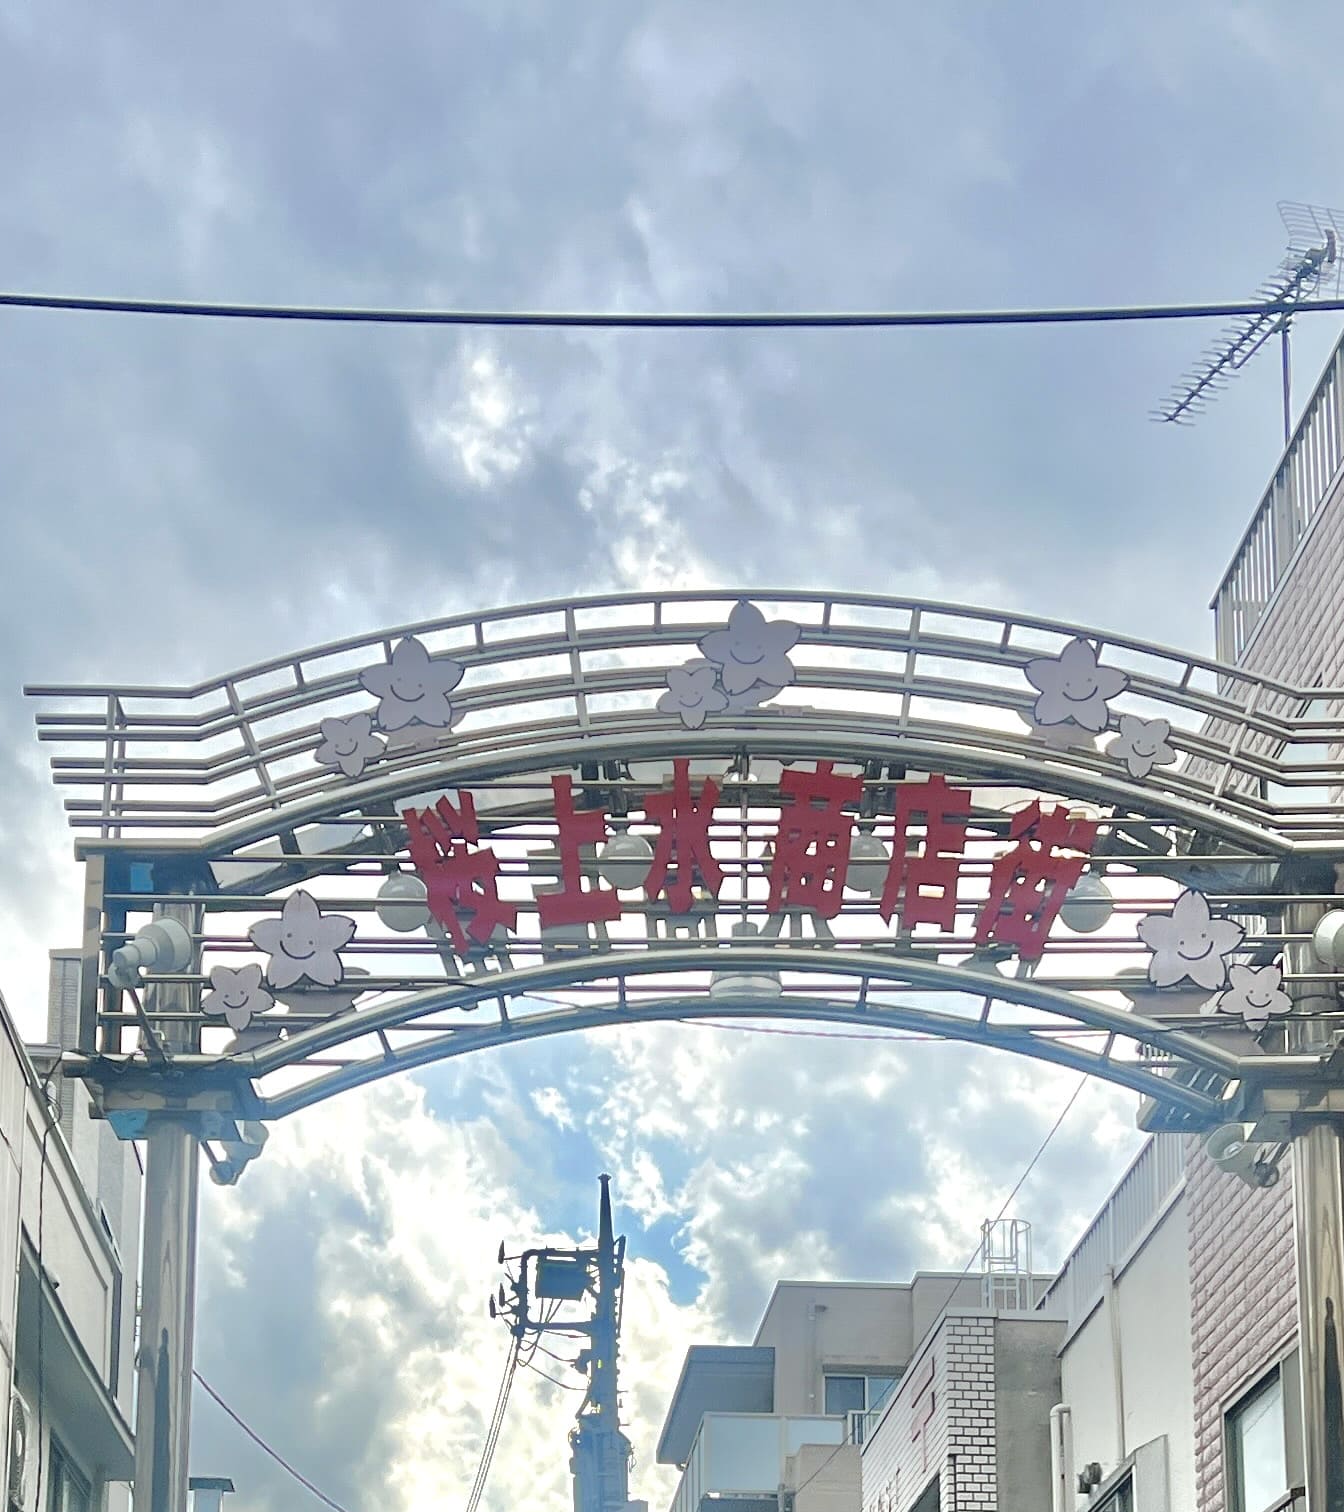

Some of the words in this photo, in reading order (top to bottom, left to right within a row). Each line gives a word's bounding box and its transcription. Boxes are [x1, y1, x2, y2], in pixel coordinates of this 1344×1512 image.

[402, 758, 1095, 961] 桜上水商店街
